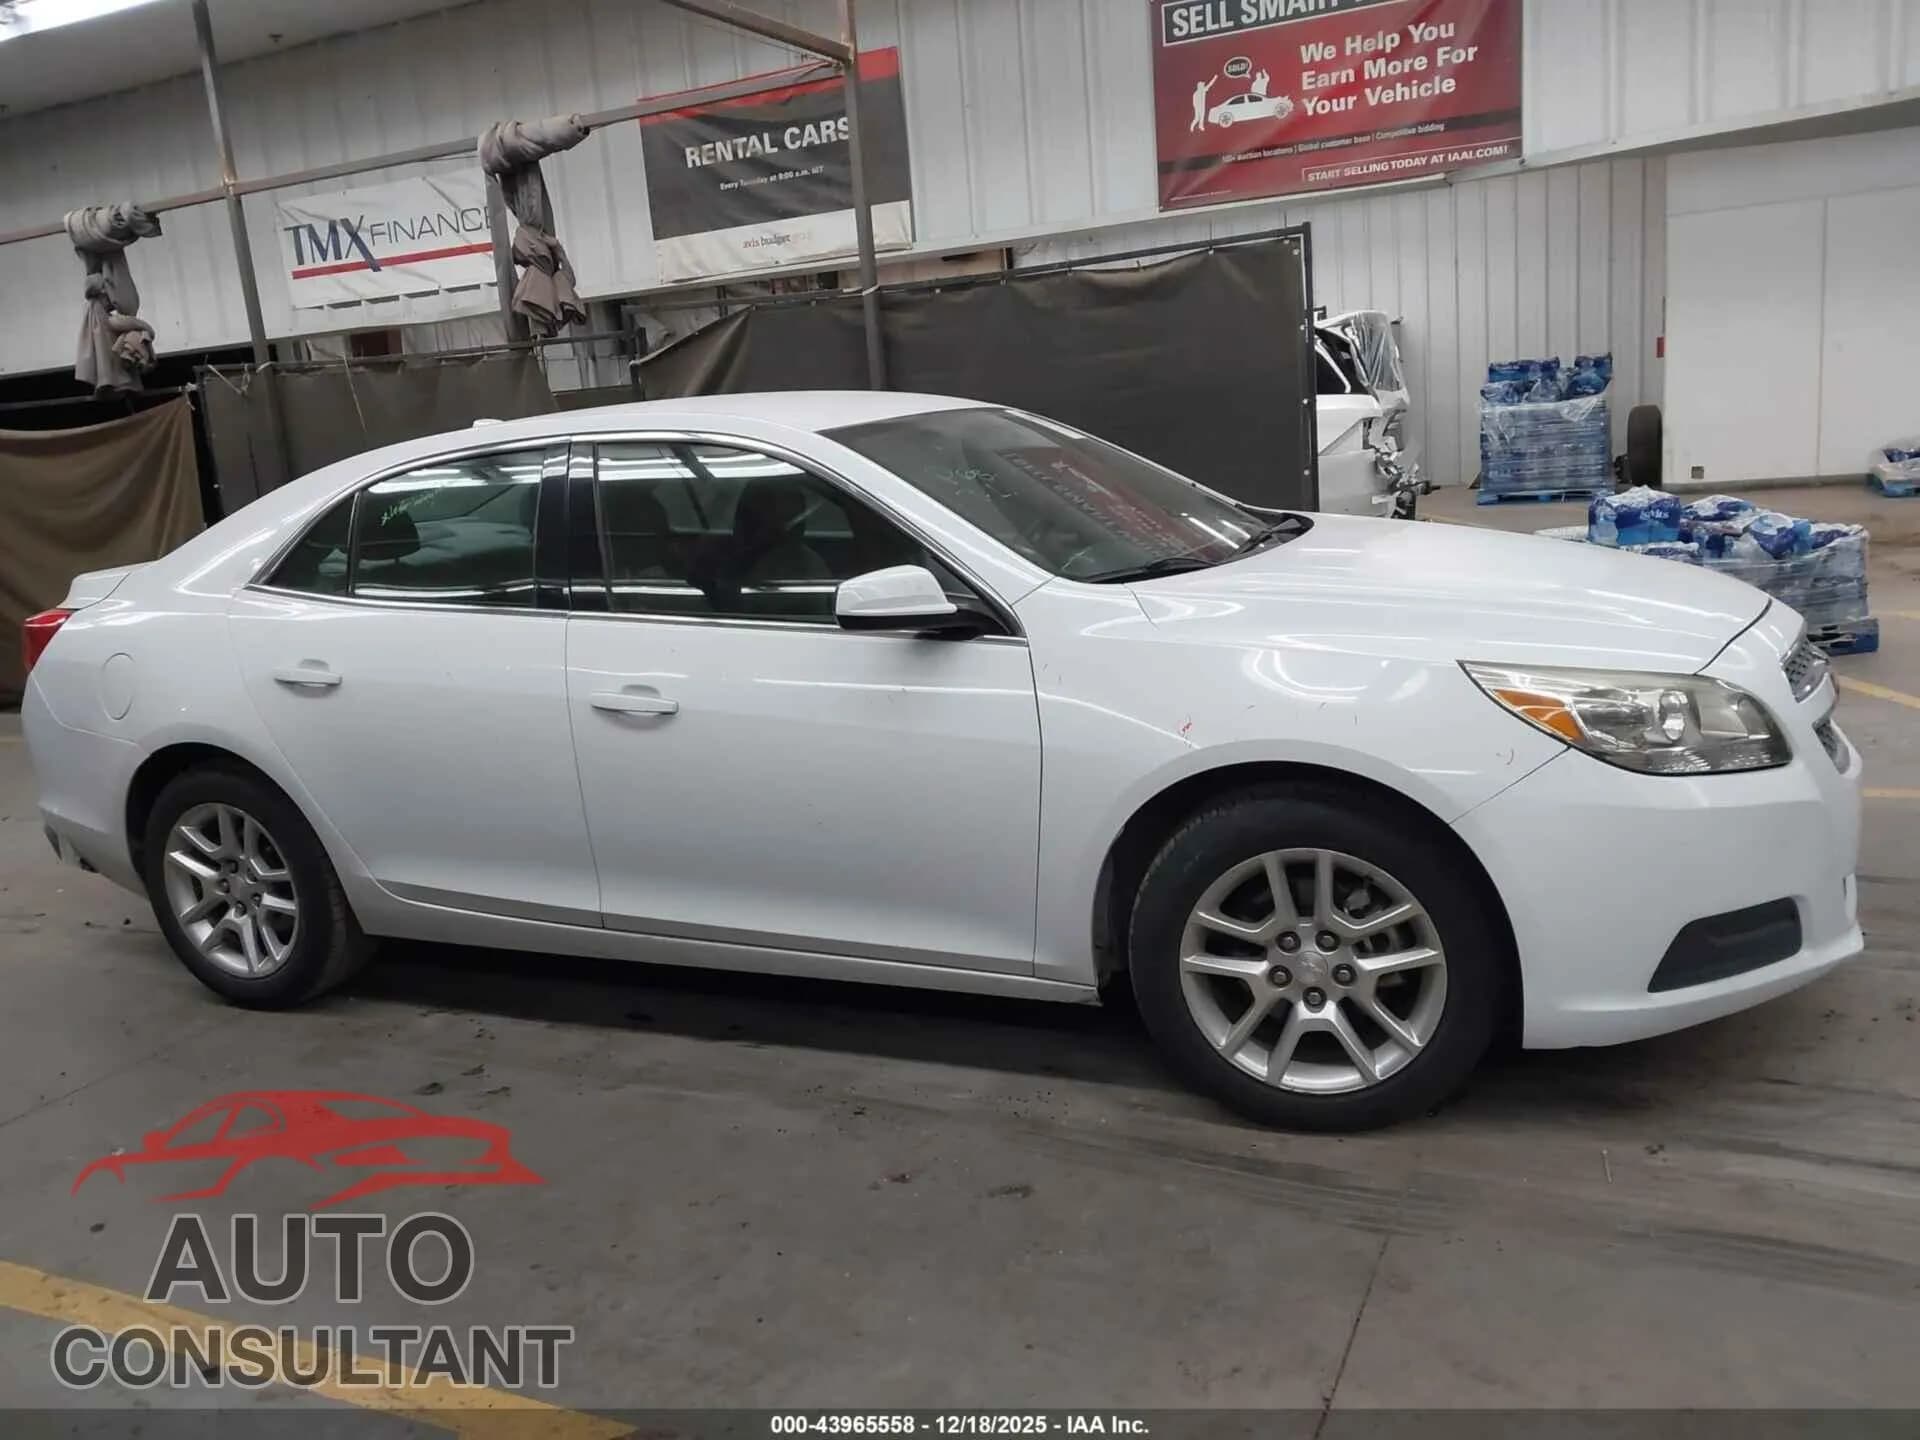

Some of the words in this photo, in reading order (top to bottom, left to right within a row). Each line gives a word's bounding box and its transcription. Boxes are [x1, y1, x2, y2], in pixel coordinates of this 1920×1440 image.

[1172, 0, 1234, 37] SELL
[1300, 42, 1337, 64] We
[1344, 30, 1401, 56] Help
[1407, 22, 1455, 44] You
[1302, 68, 1355, 90] Earn
[1363, 55, 1428, 80] More
[1437, 46, 1478, 67] For
[1303, 95, 1358, 116] Your
[1364, 76, 1456, 106] Vehicle
[685, 132, 778, 168] RENTAL
[784, 117, 849, 150] CARS
[1307, 170, 1341, 182] START
[1343, 162, 1389, 177] SELLING
[1391, 156, 1428, 169] TODAY
[1430, 153, 1445, 164] AT
[284, 215, 382, 272] TMX
